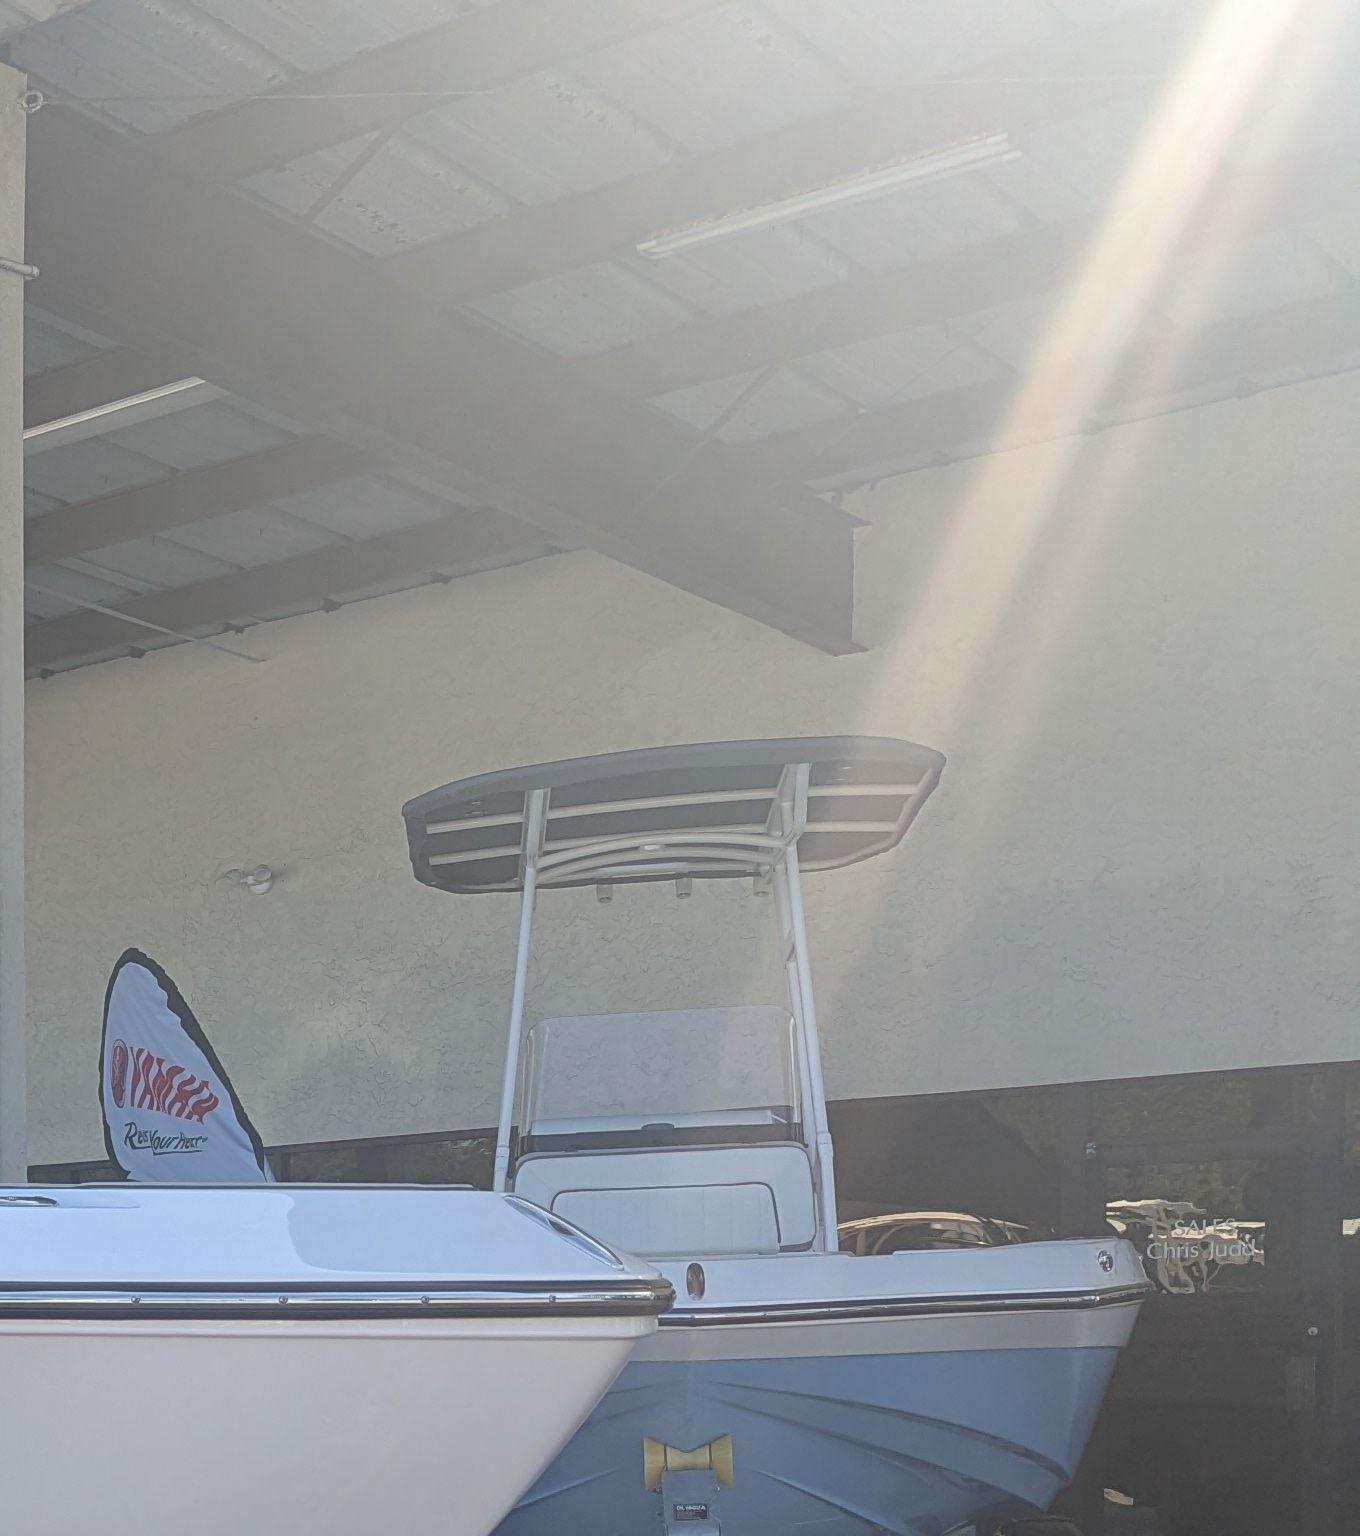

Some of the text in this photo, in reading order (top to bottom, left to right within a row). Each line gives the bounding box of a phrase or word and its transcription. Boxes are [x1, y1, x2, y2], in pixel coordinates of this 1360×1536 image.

[130, 1046, 220, 1125] YAMAHA
[1174, 1218, 1236, 1236] SALES
[1146, 1239, 1255, 1261] Chris Judd
